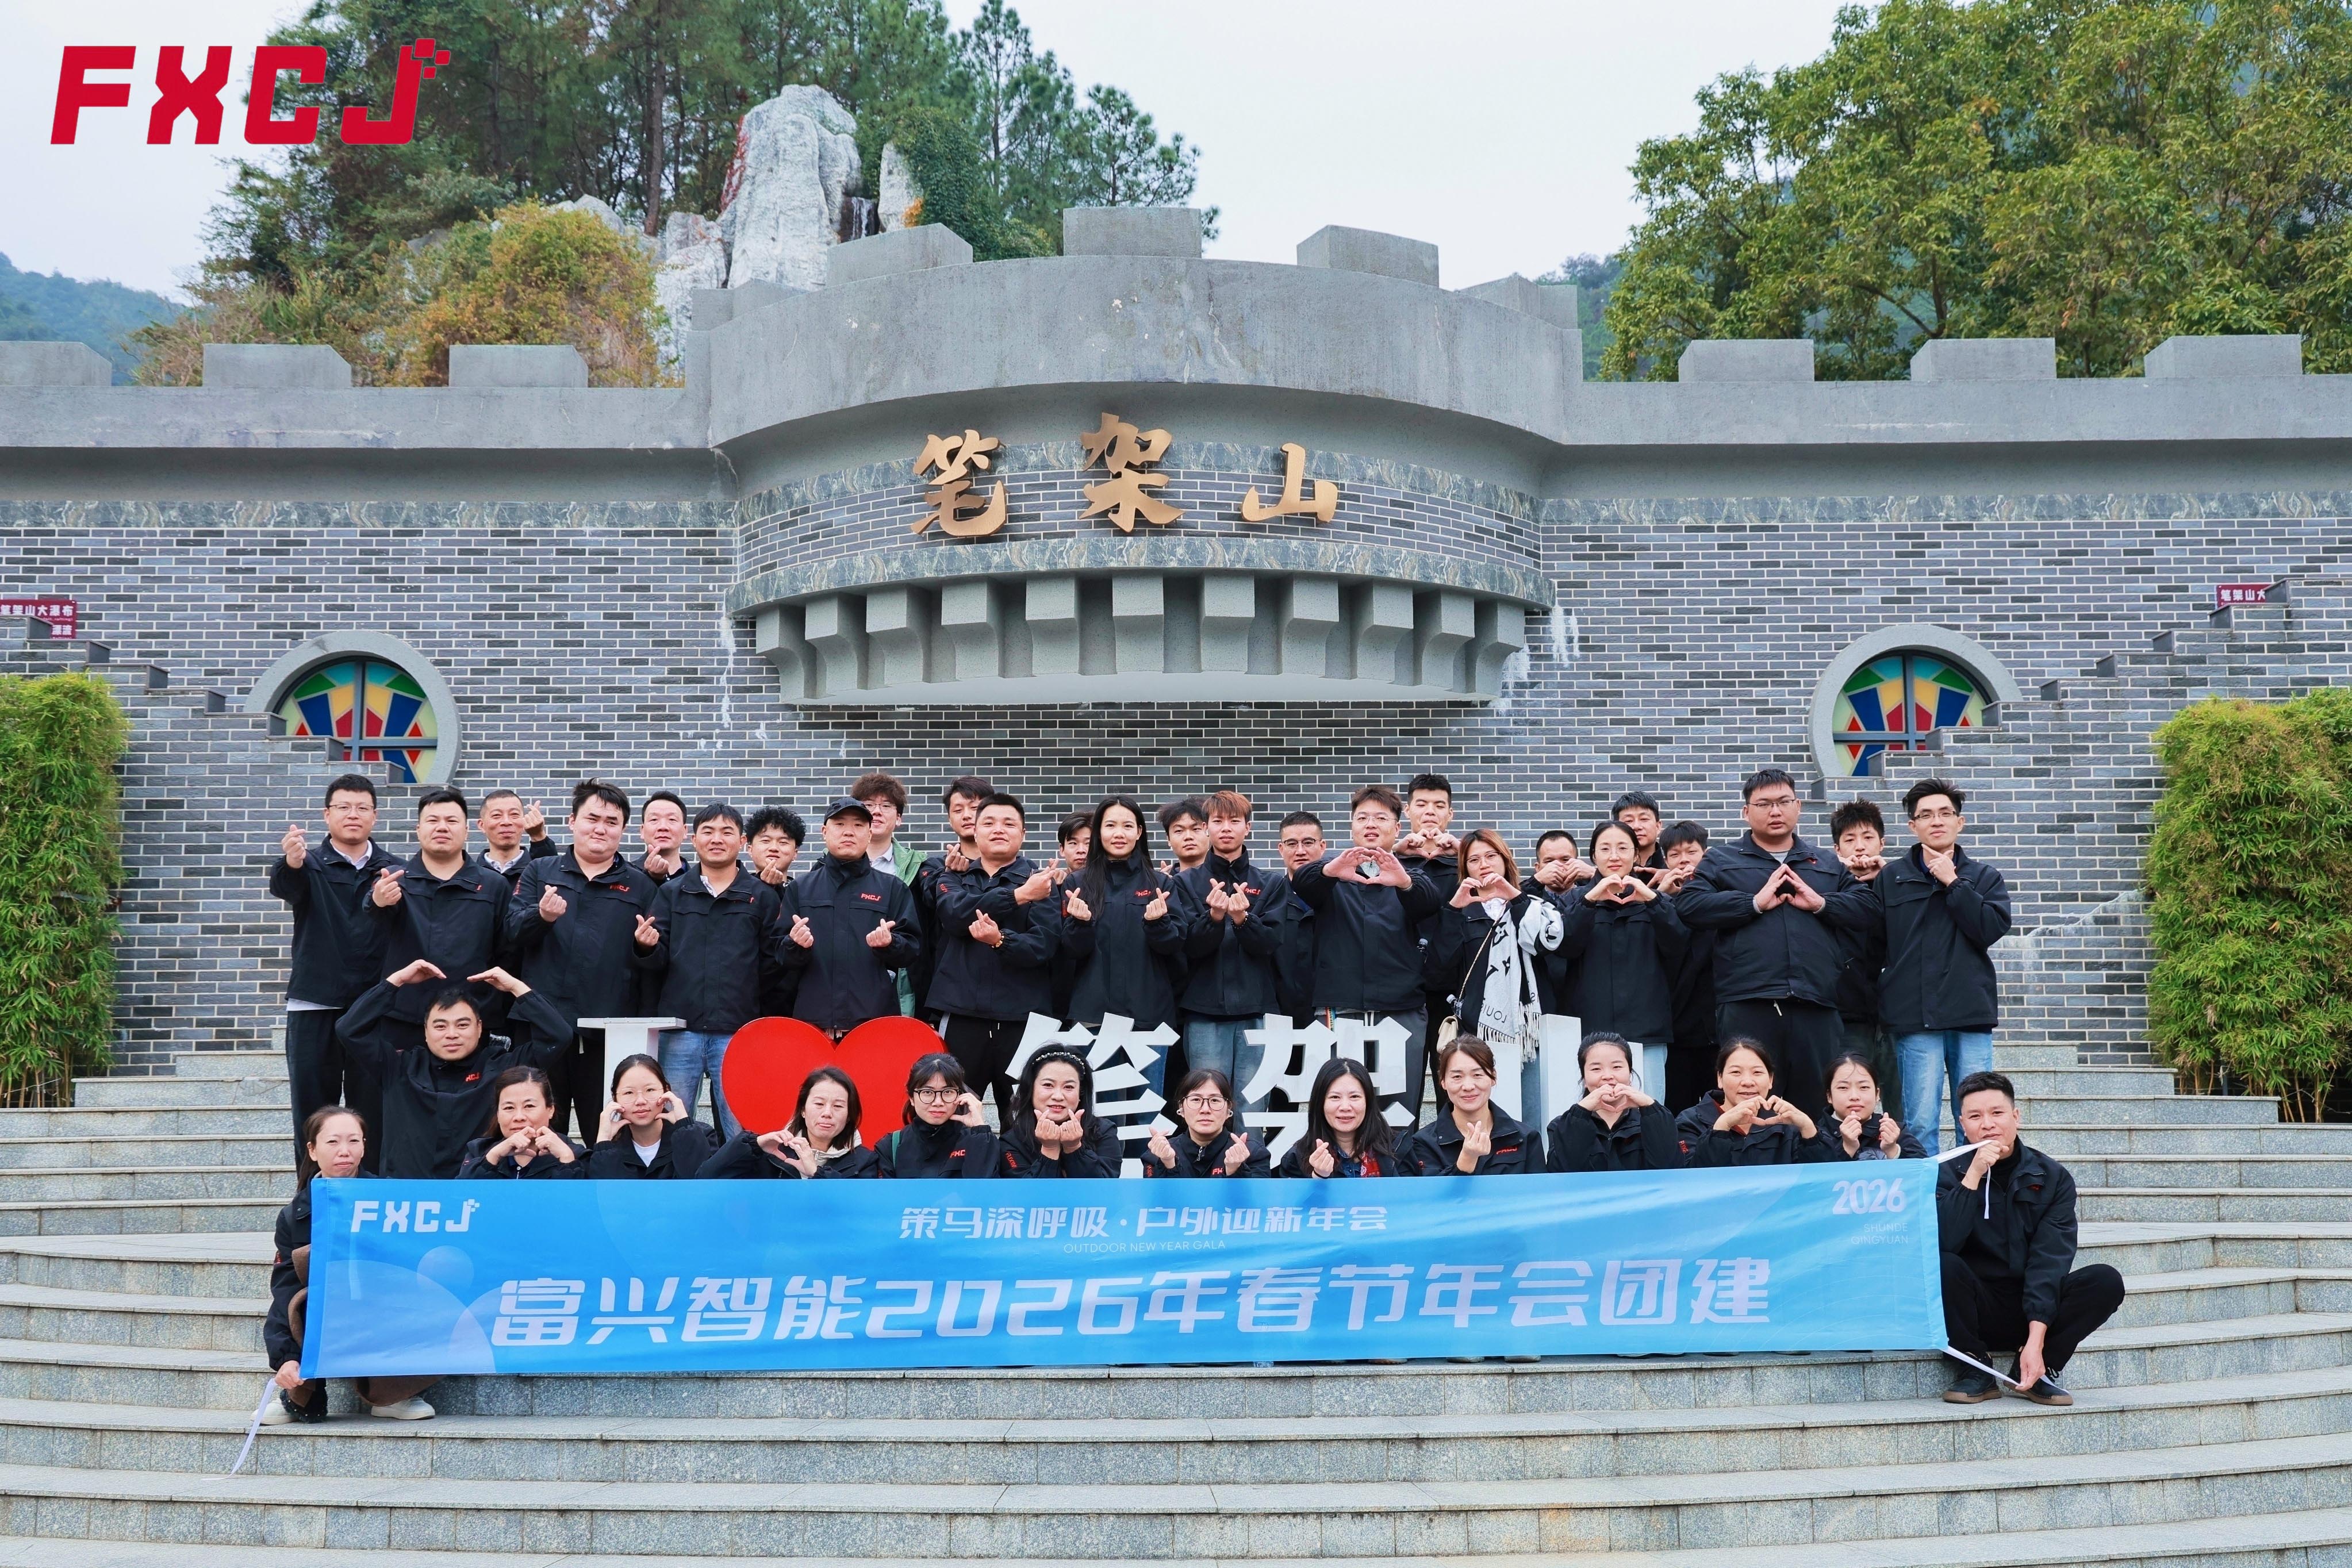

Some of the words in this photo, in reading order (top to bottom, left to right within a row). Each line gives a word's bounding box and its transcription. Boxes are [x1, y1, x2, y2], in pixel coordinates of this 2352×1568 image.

[911, 412, 1338, 536] 笔架山
[1832, 1178, 1906, 1215] 2026
[350, 1199, 479, 1232] FXCJ
[1864, 1223, 1908, 1232] SHUNDE
[1064, 1243, 1126, 1253] OUTDOOR
[1130, 1242, 1156, 1252] NEW
[1160, 1241, 1189, 1251] YEAR
[1193, 1240, 1226, 1250] GALA
[1851, 1235, 1908, 1245] QINGYUAN
[490, 1257, 1771, 1346] 富兴智能2026年春节年会团建
